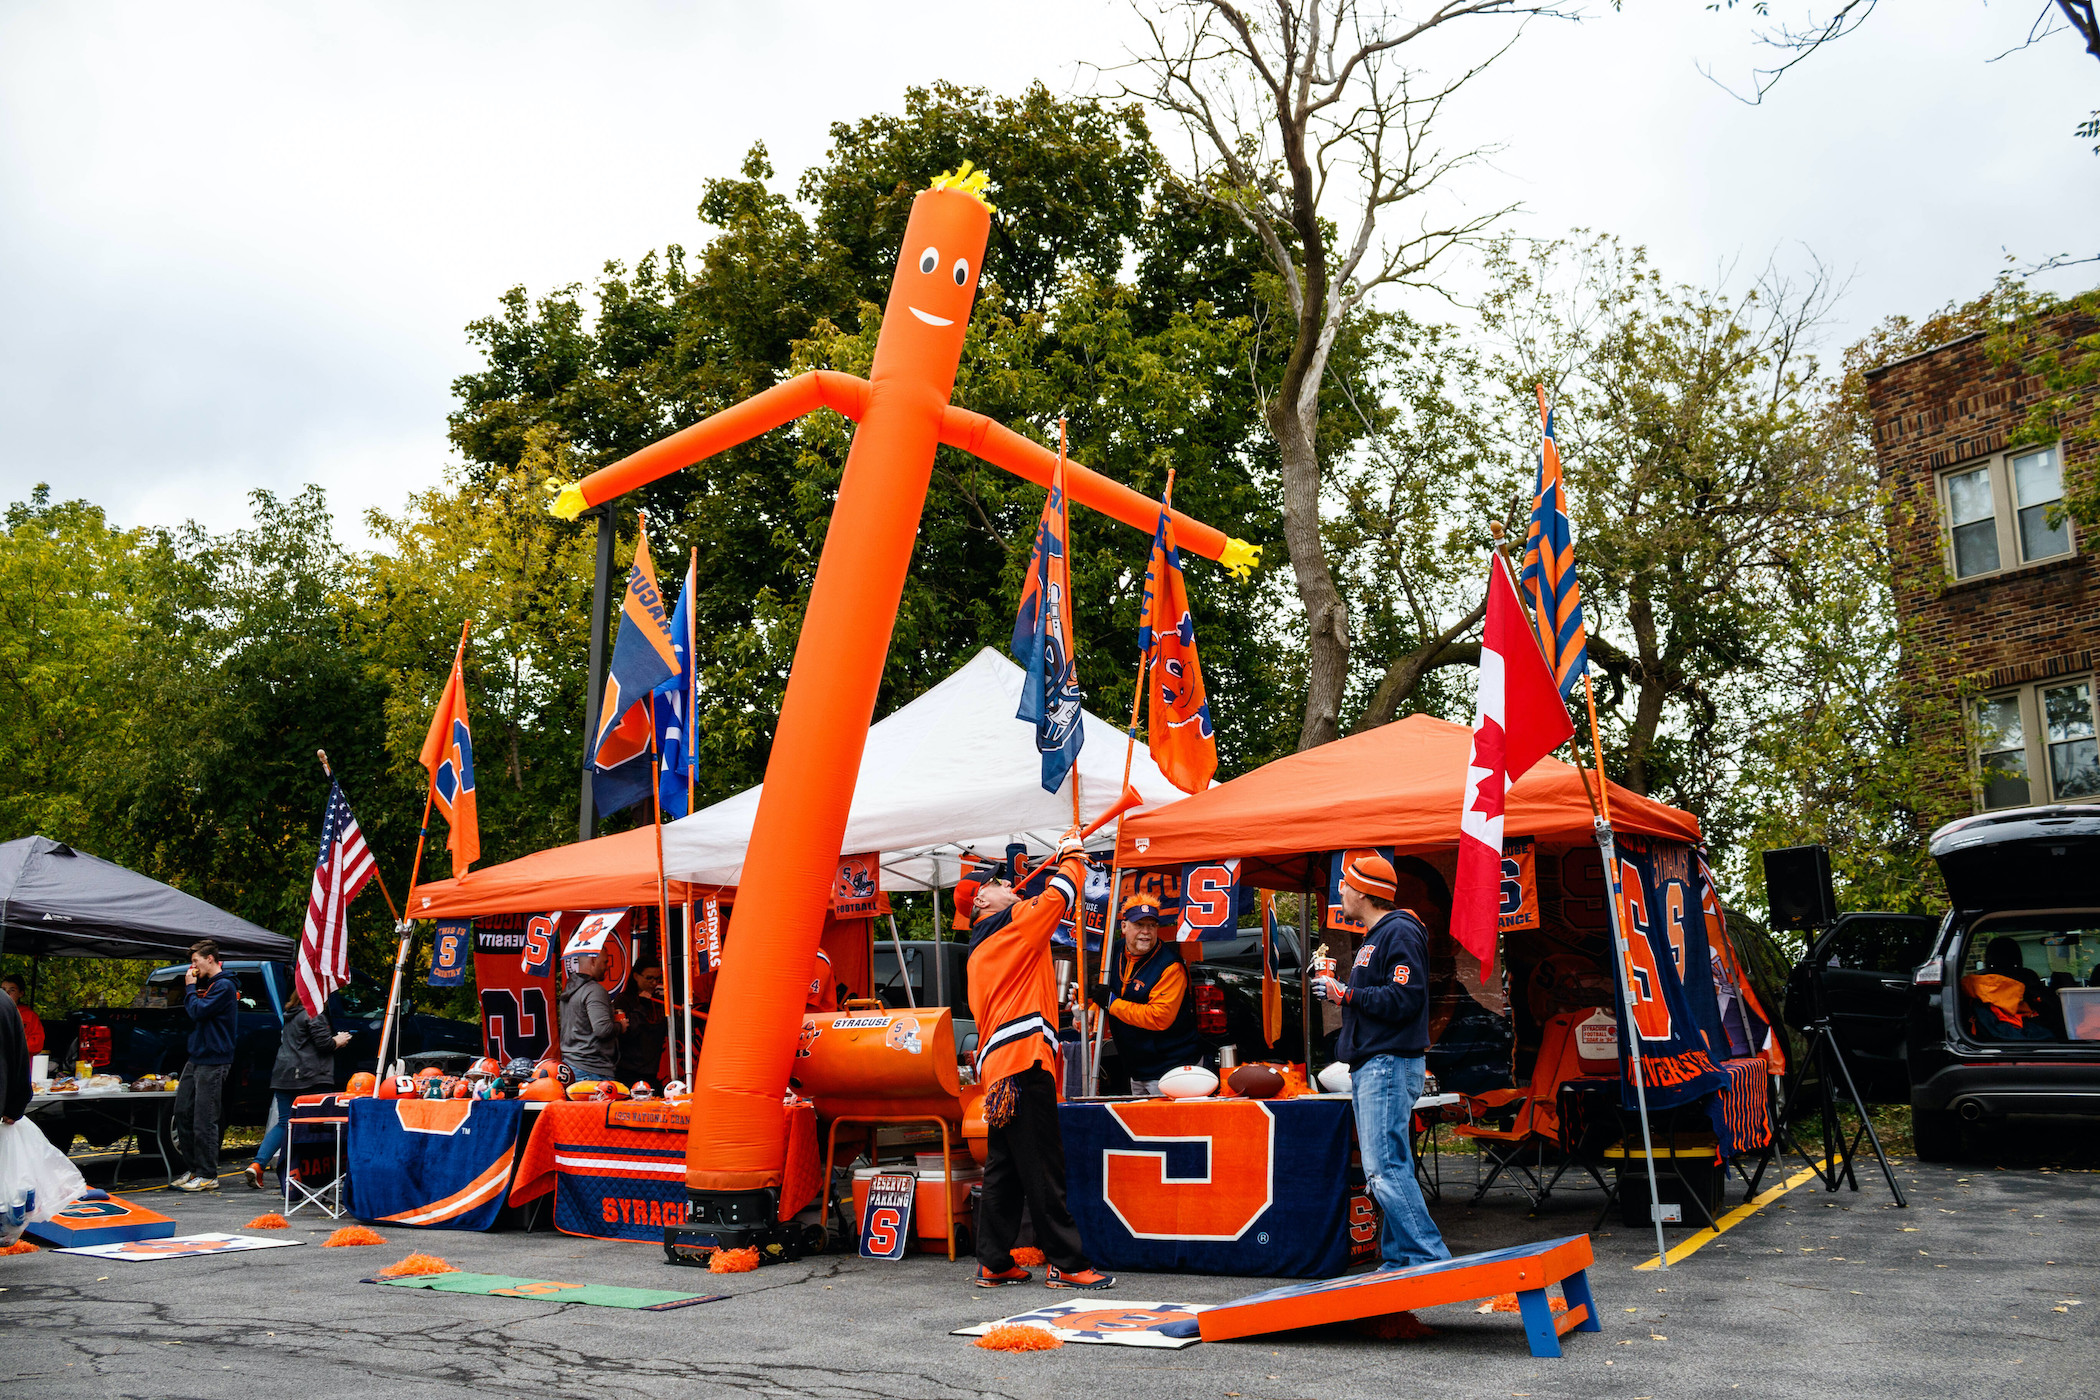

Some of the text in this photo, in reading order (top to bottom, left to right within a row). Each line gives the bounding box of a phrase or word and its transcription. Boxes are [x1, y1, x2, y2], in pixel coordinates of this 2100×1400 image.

[843, 867, 851, 879] S
[1185, 865, 1232, 928] S
[836, 901, 878, 914] FOOTBALL
[438, 927, 466, 936] THIS IS
[695, 920, 708, 953] S
[706, 898, 721, 968] SYRACUSE
[525, 916, 553, 966] S
[1621, 858, 1672, 1041] S
[439, 935, 459, 967] S
[433, 967, 462, 979] COUNTRY
[1393, 964, 1410, 985] S
[833, 1017, 891, 1028] SYRACUSE
[894, 1022, 903, 1033] S
[556, 1065, 572, 1084] S
[605, 1085, 613, 1094] S
[462, 1127, 471, 1135] TM
[871, 1176, 911, 1192] RESERVED
[869, 1191, 909, 1208] PARKING
[1350, 1195, 1373, 1243] S
[868, 1208, 900, 1255] S
